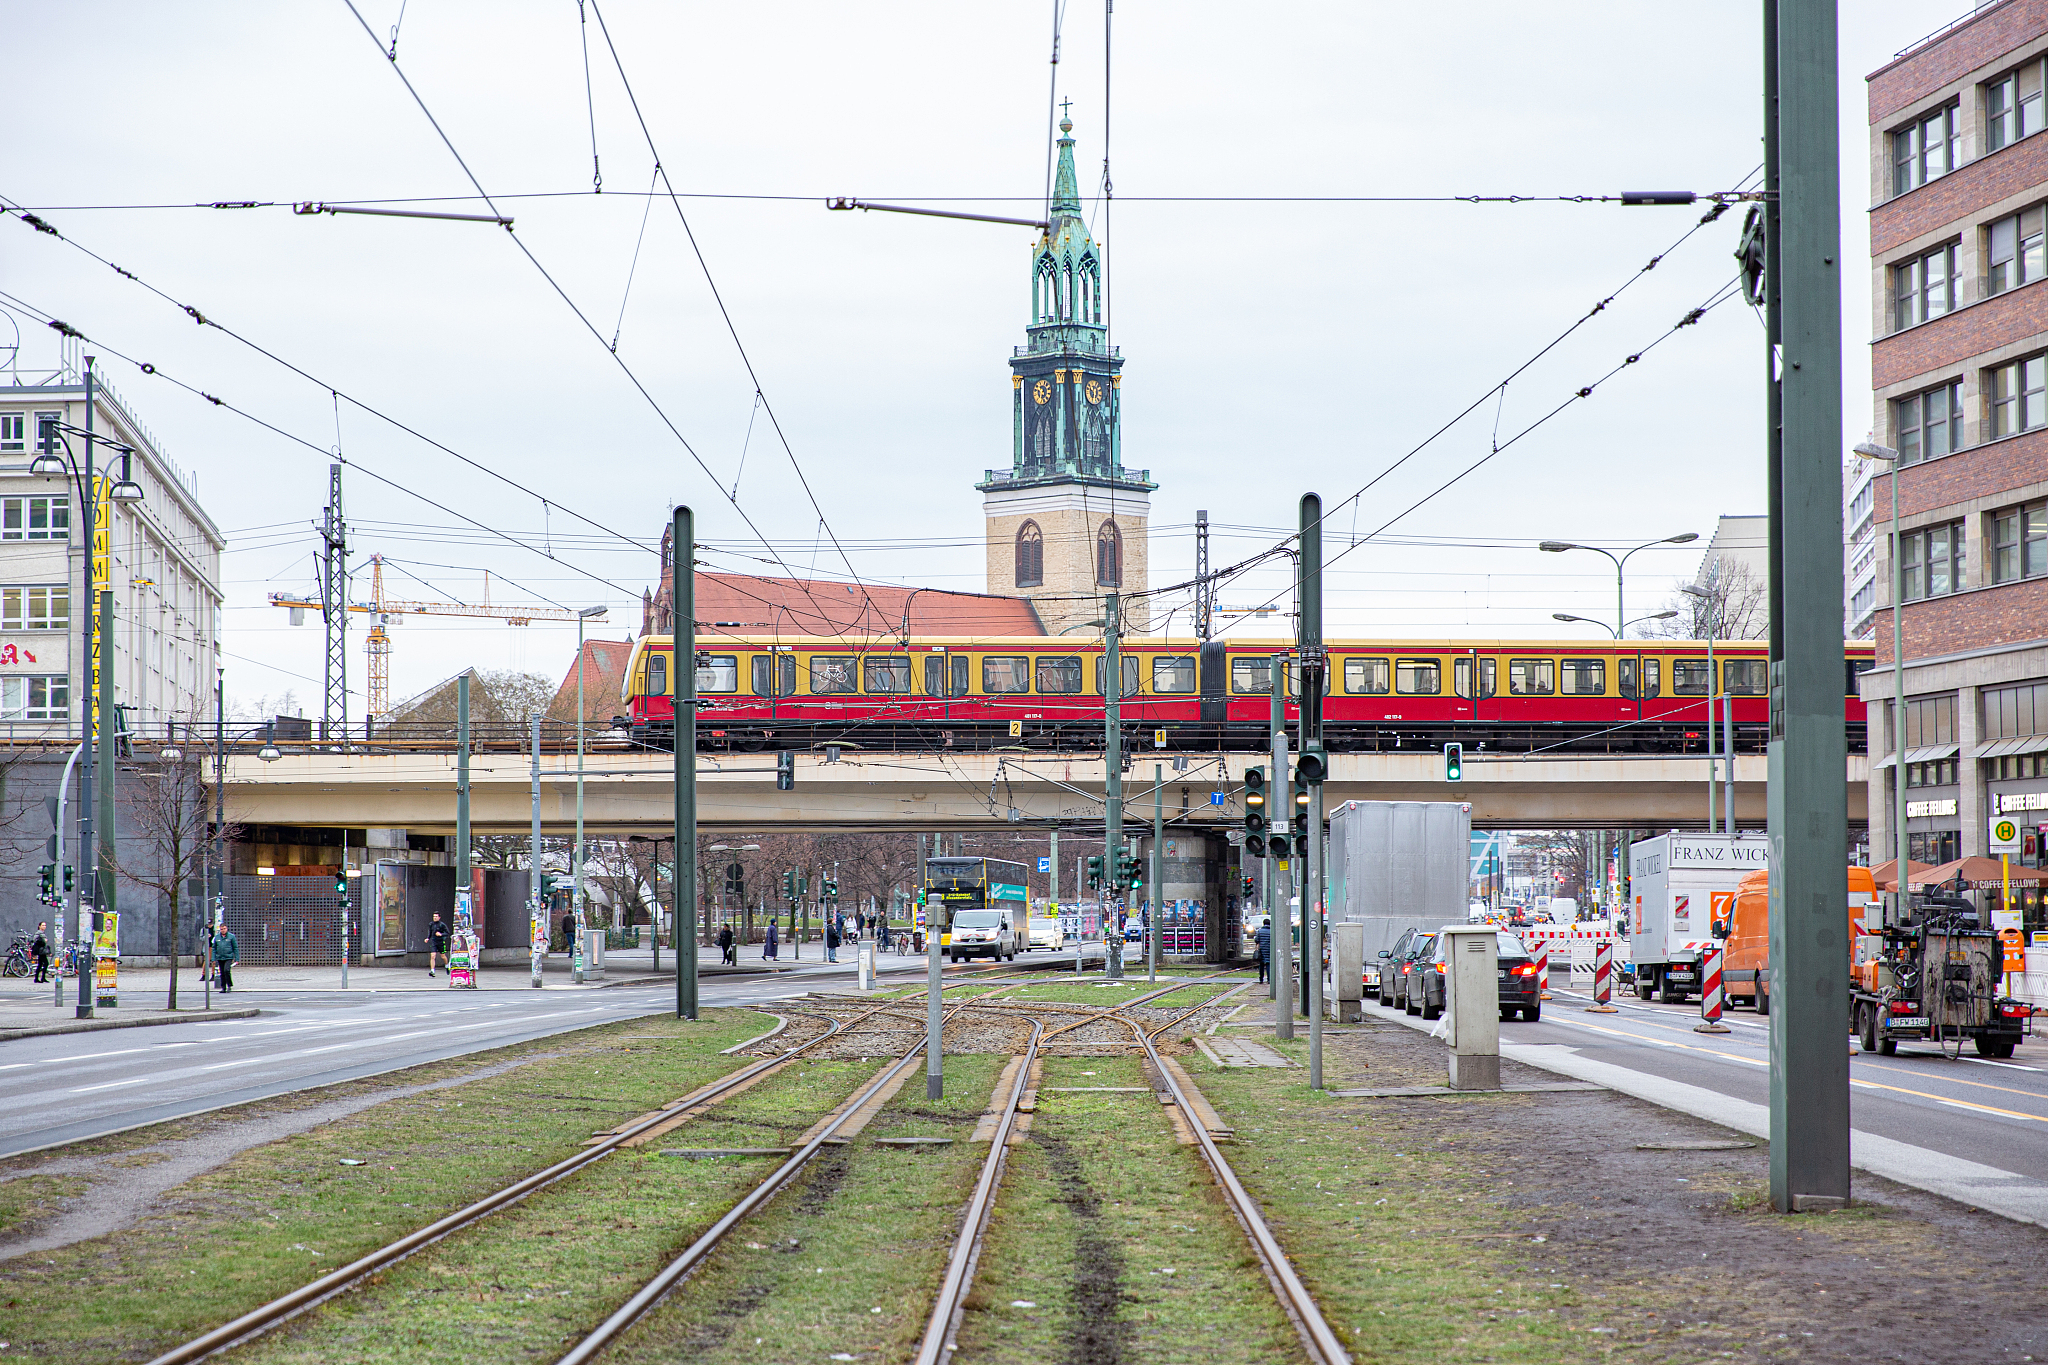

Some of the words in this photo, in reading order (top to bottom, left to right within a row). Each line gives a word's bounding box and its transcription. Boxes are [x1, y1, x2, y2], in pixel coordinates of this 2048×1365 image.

[1012, 723, 1019, 735] 2
[1157, 731, 1164, 742] 1
[1214, 793, 1222, 804] T
[2001, 794, 2025, 812] COFFEE
[1907, 801, 1929, 818] COFFEE
[1928, 798, 1957, 816] FELLOWS
[1674, 847, 1725, 861] FRANZ
[2008, 878, 2041, 889] FELLOWS
[1891, 1018, 1896, 1026] B
